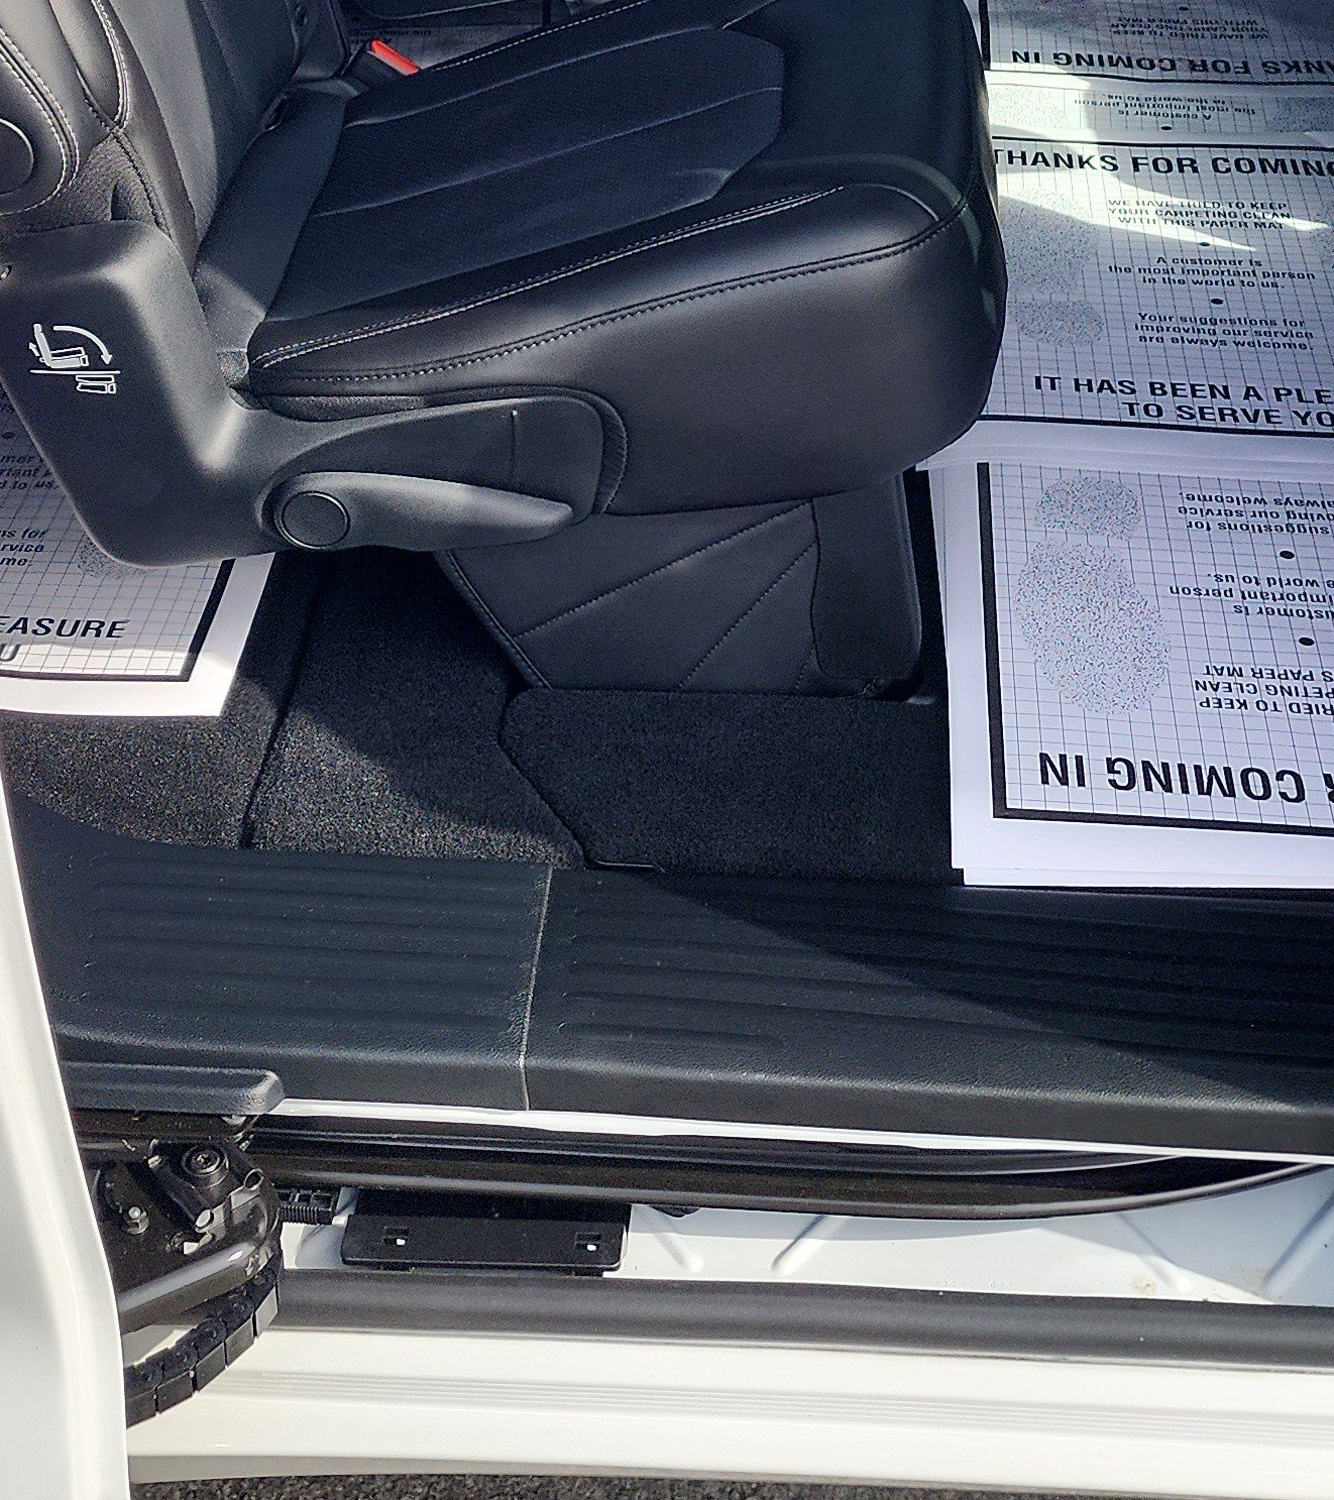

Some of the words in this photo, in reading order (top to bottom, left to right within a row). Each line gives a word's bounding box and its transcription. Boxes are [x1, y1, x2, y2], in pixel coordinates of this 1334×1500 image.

[1012, 51, 1040, 63] IN
[1053, 52, 1177, 72] COMING
[1184, 56, 1253, 75] FOR
[993, 149, 1119, 172] THANKS
[1131, 156, 1199, 174] FOR
[1250, 202, 1287, 210] KEEP
[1155, 209, 1238, 219] CARPETING
[1243, 211, 1291, 220] CLEAN
[1163, 219, 1195, 227] THIS
[1200, 220, 1249, 229] PAPER
[1253, 221, 1286, 230] MAT
[1156, 256, 1168, 264] A
[1172, 257, 1244, 267] customer
[1249, 258, 1263, 267] is
[1108, 265, 1132, 273] the
[1137, 266, 1176, 275] most
[1181, 266, 1257, 278] important
[1262, 271, 1316, 281] person
[1142, 275, 1157, 284] in
[1162, 276, 1187, 285] the
[1192, 277, 1235, 287] world
[1240, 279, 1255, 288] to
[1260, 280, 1285, 289] us.
[1137, 312, 1174, 322] Your
[1179, 315, 1278, 327] suggestions
[1282, 318, 1305, 328] for
[1135, 323, 1217, 336] improving
[1222, 328, 1249, 337] our
[1254, 329, 1314, 339] service
[1138, 335, 1164, 344] are
[1170, 335, 1228, 347] always
[1233, 339, 1314, 350] welcome.
[1034, 375, 1062, 391] IT
[1073, 377, 1136, 396] HAS
[1149, 381, 1231, 400] BEEN
[1242, 385, 1264, 401] A
[1121, 401, 1164, 419] TO
[1176, 406, 1282, 425] SERVE
[1179, 492, 1267, 505] welcome.
[1178, 506, 1244, 517] service
[1250, 509, 1280, 519] our
[1186, 521, 1211, 531] for
[1217, 521, 1330, 536] suggestions
[21, 528, 49, 539] for
[1207, 573, 1236, 584] us.
[1242, 575, 1261, 586] to
[1266, 576, 1319, 588] world
[1169, 585, 1234, 598] person
[1240, 589, 1333, 605] important
[1233, 604, 1250, 615] is
[1203, 664, 1243, 677] MAT
[1251, 667, 1315, 681] PAPER
[1194, 679, 1258, 695] CLEAN
[1199, 697, 1249, 711] KEEP
[1255, 700, 1282, 713] TO
[1038, 752, 1085, 787] IN
[1105, 757, 1307, 804] COMING
